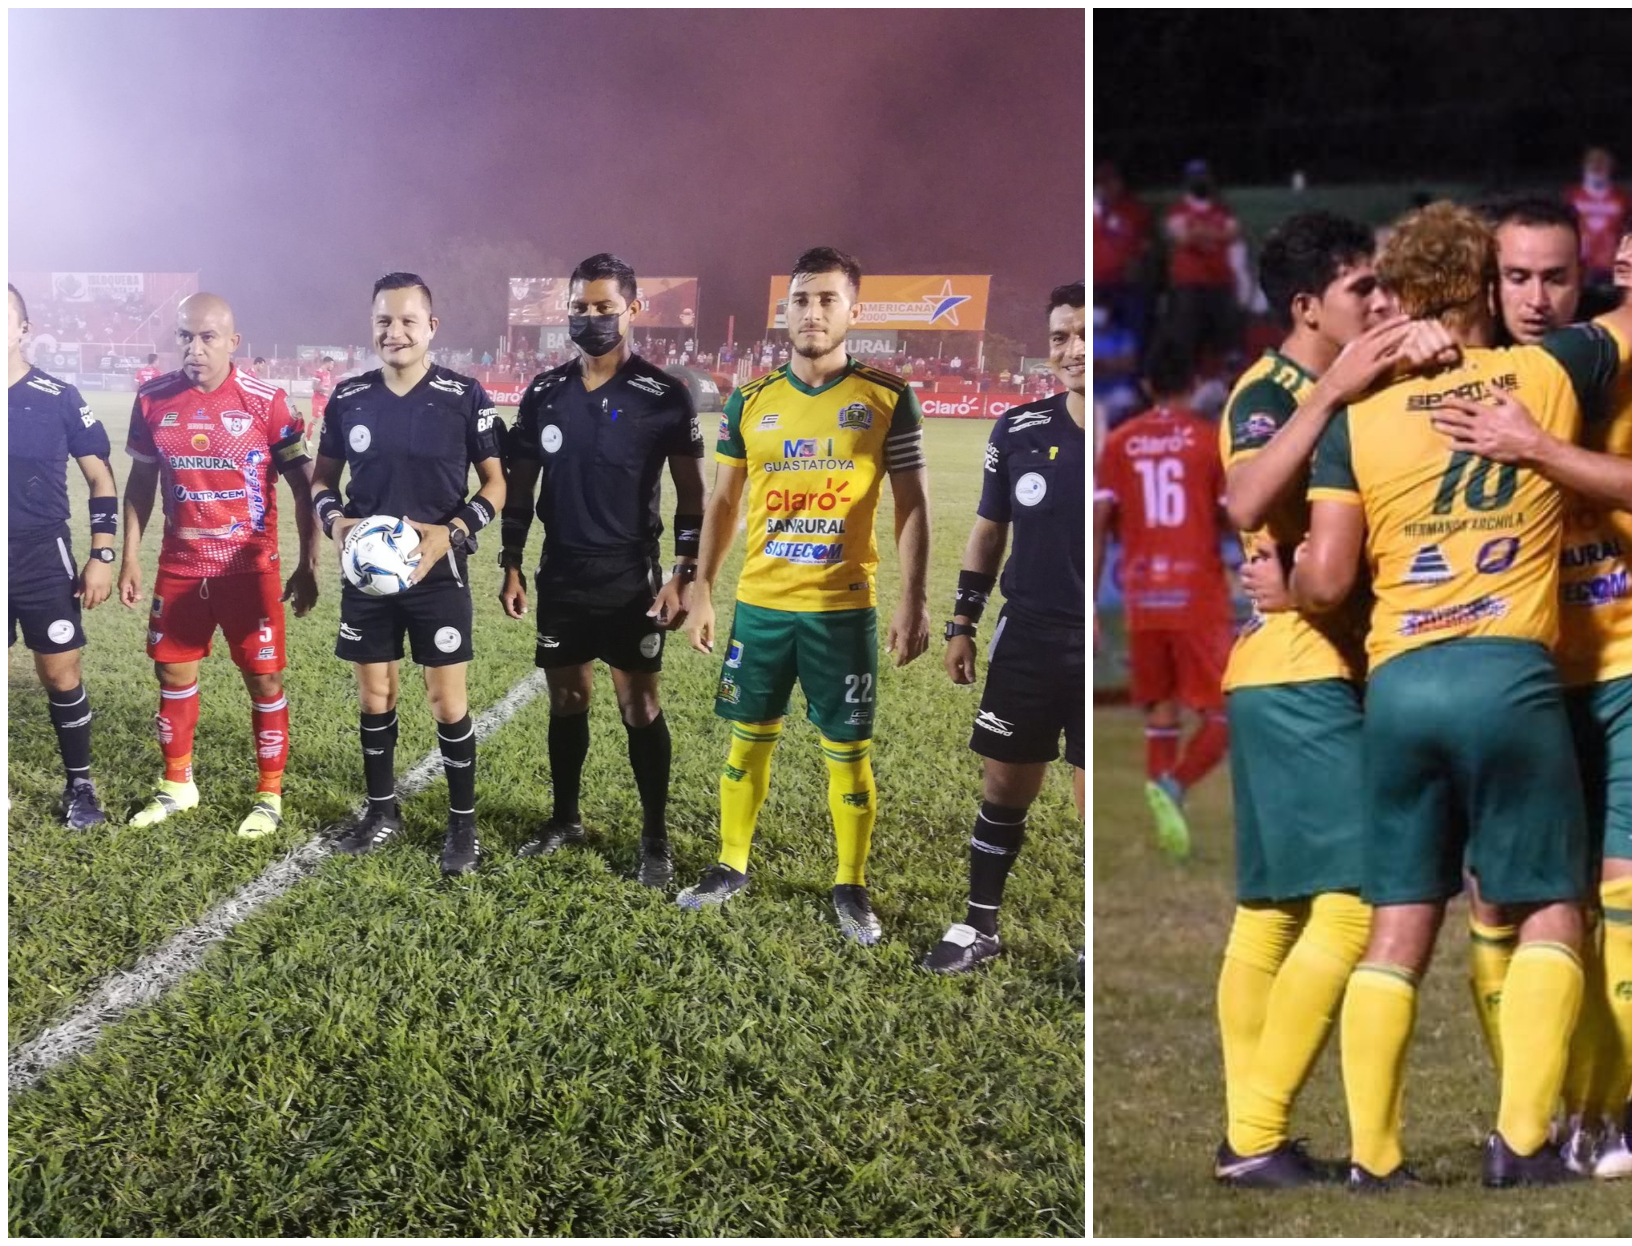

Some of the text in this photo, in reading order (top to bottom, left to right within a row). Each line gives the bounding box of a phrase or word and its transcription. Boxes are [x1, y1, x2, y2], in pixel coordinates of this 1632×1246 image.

[861, 313, 887, 321] 2000
[845, 340, 896, 353] URAL
[922, 398, 974, 415] Claro
[1125, 429, 1188, 456] Claro
[170, 457, 237, 470] BANRURAL
[764, 460, 855, 473] GUASTATOYA
[188, 490, 245, 500] ULTRACEM
[767, 484, 843, 511] Claro
[1133, 458, 1187, 529] 16
[767, 518, 846, 534] BANRURAL
[765, 541, 844, 559] SISTECOM
[258, 617, 273, 643] 5
[844, 672, 873, 703] 22
